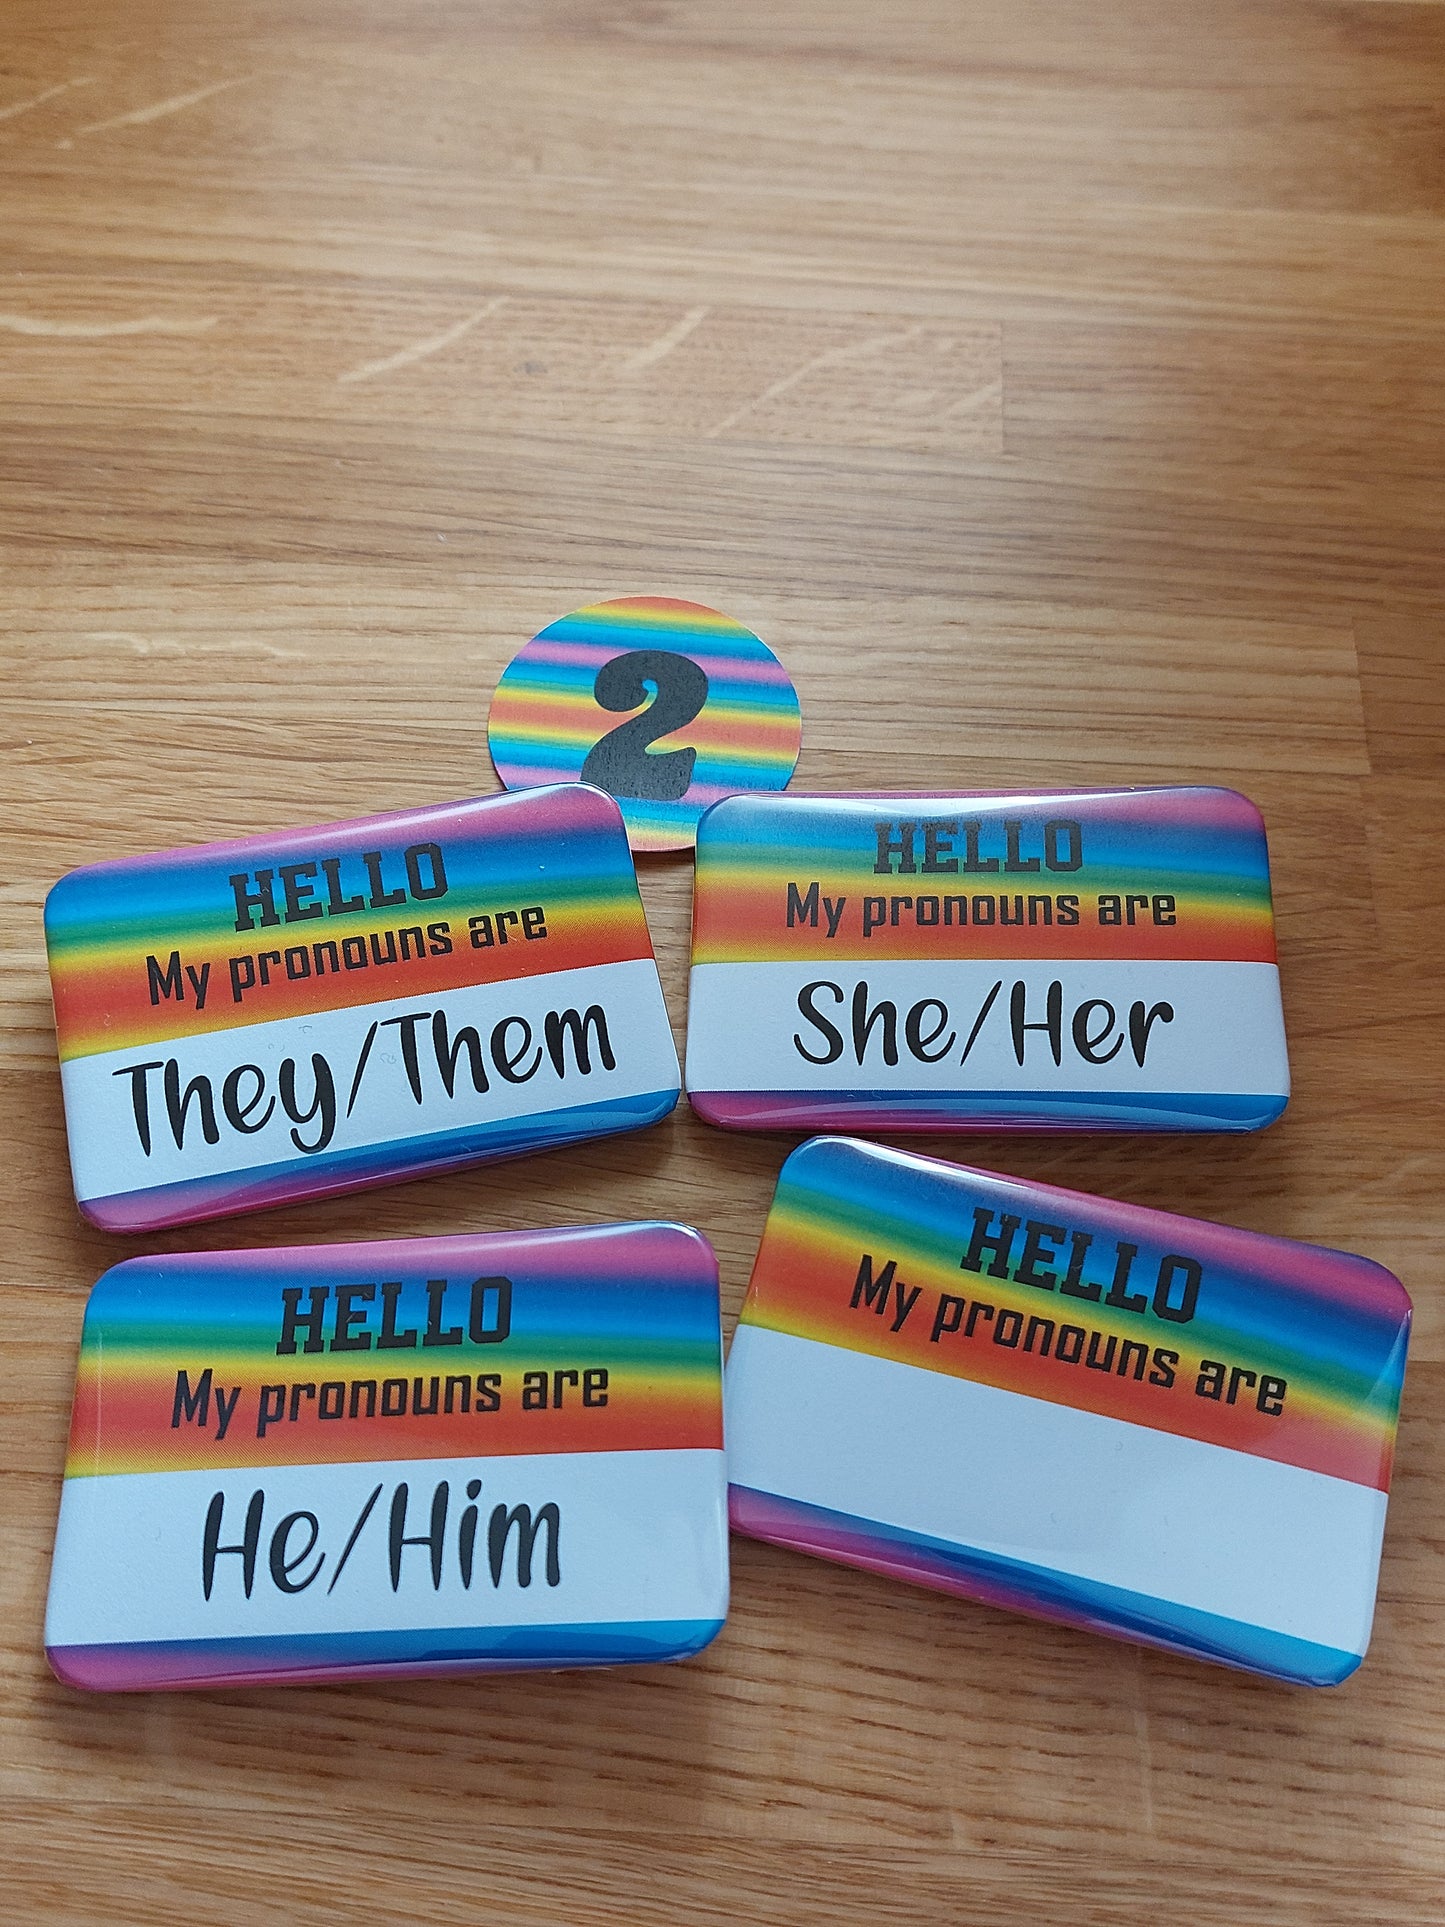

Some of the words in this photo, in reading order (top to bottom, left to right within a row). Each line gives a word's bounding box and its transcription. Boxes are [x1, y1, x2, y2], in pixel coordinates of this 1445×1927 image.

[580, 650, 708, 801] 2
[229, 842, 448, 931] HELLO
[874, 819, 1083, 874] HELLO
[786, 882, 845, 937] My
[863, 894, 1080, 937] pronouns
[1098, 894, 1176, 926] are
[146, 951, 210, 1010] My
[230, 921, 452, 1002] pronouns
[470, 907, 547, 948] are
[794, 979, 1174, 1068] She/Her
[112, 1003, 616, 1157] They/Them
[960, 1207, 1202, 1324] HELLO
[275, 1276, 512, 1354] HELLO
[849, 1254, 921, 1332] My
[931, 1293, 1179, 1388] pronouns
[1195, 1358, 1287, 1416] are
[171, 1368, 241, 1440] My
[257, 1372, 501, 1438] pronouns
[522, 1367, 608, 1409] are
[203, 1479, 560, 1601] He/Him
